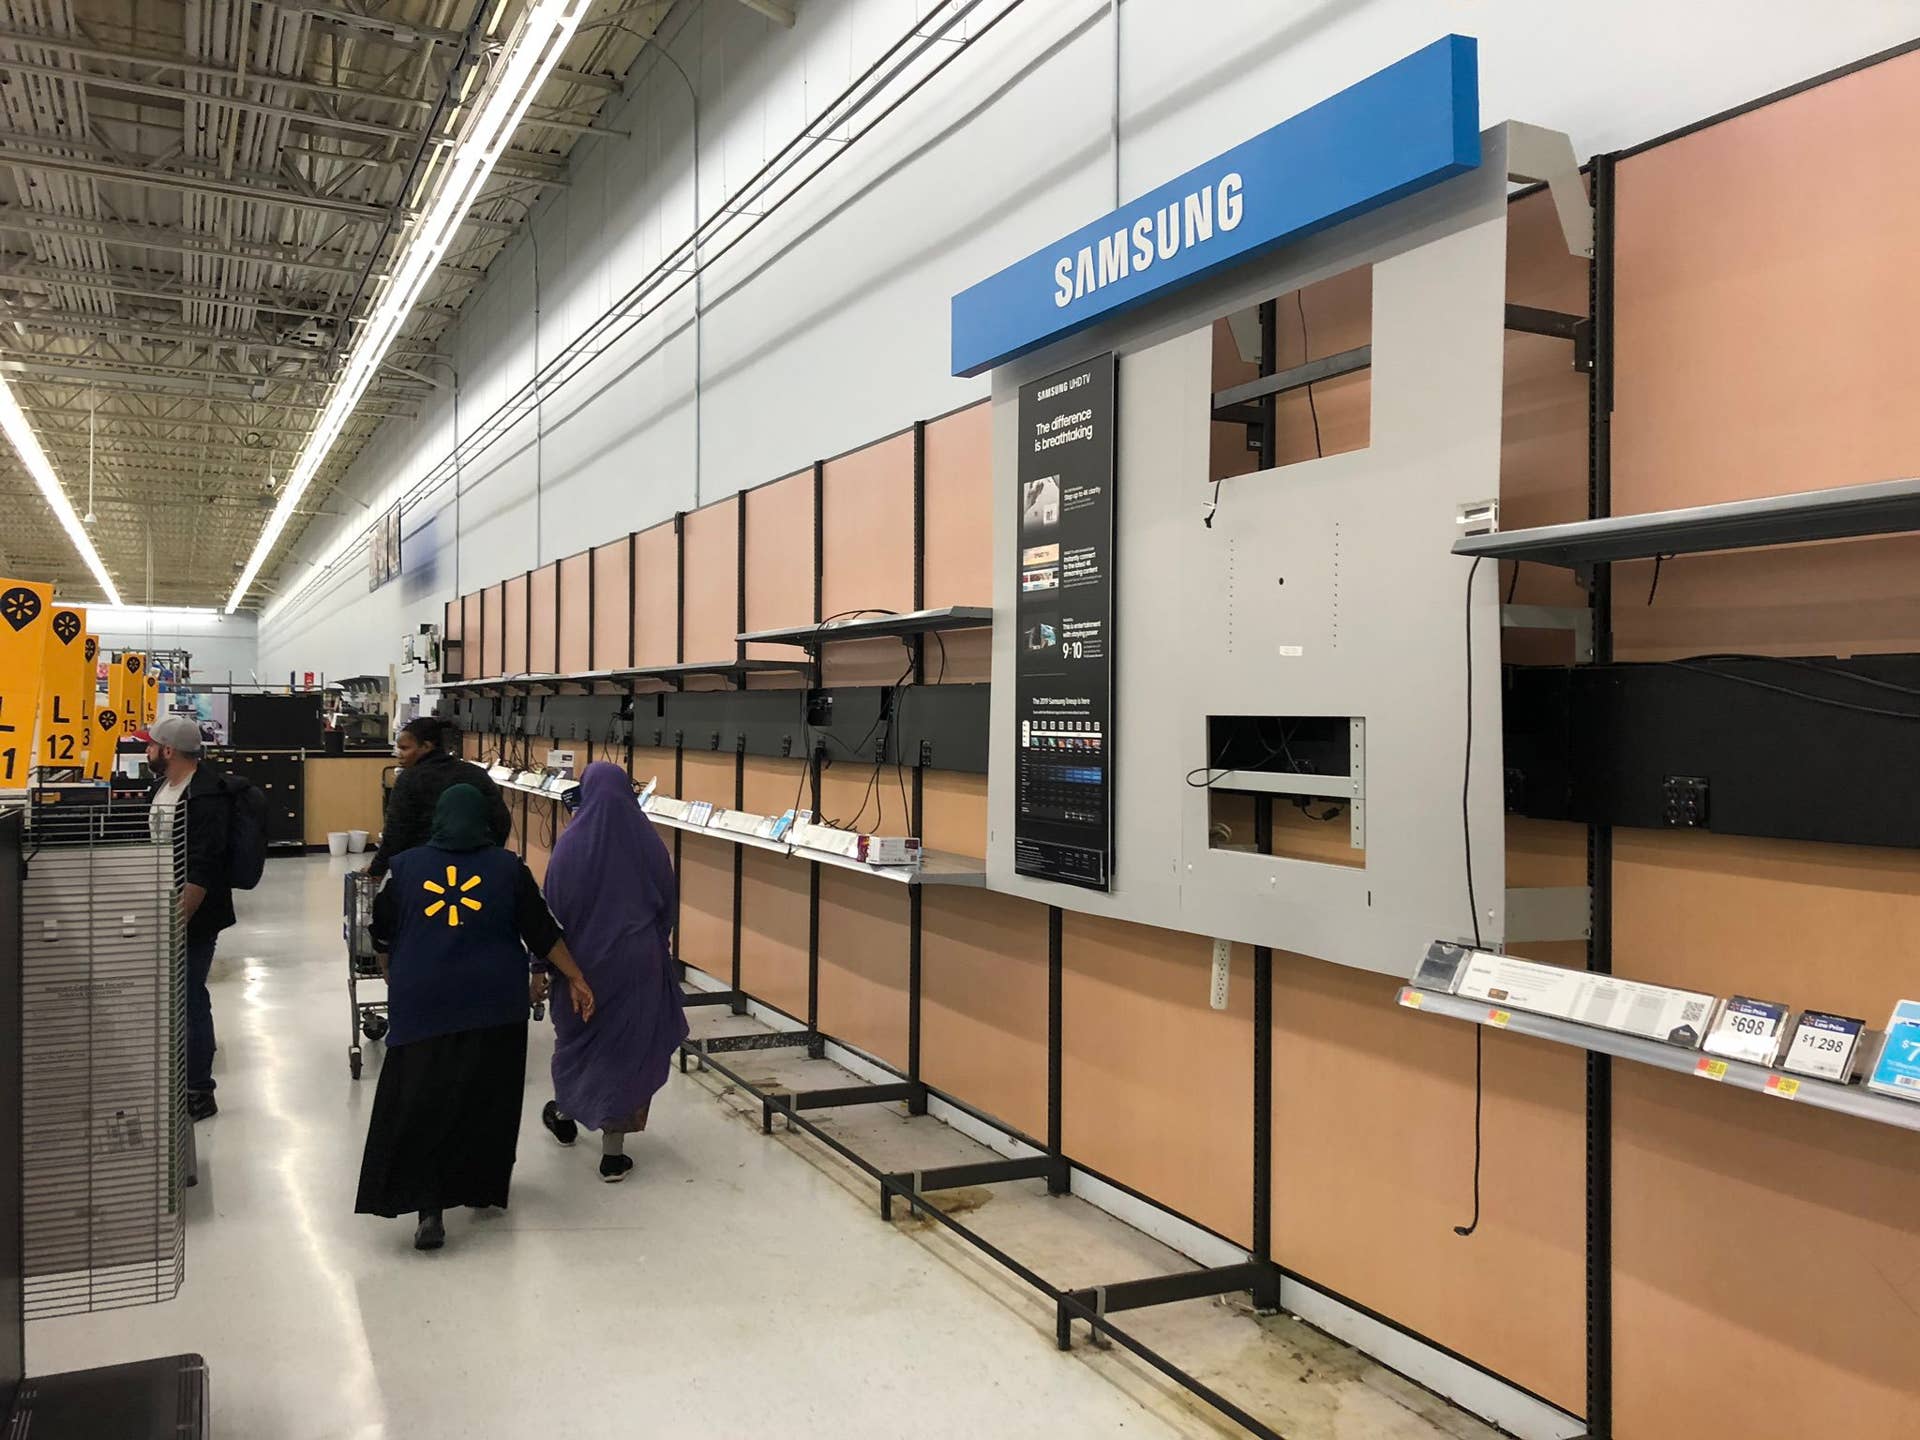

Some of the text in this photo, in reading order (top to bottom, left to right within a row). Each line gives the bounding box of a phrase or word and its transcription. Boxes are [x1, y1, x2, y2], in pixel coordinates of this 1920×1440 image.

[1055, 172, 1244, 309] SAMSUNG
[1037, 381, 1068, 402] SAMSUNG
[1036, 409, 1092, 436] The difference
[1034, 425, 1093, 453] is breathtaking
[53, 695, 70, 723] L
[127, 700, 135, 714] L
[123, 719, 137, 733] 15
[47, 734, 75, 759] 12
[93, 762, 104, 780] L
[1731, 1015, 1766, 1036] $698
[1828, 1023, 1845, 1032] Price
